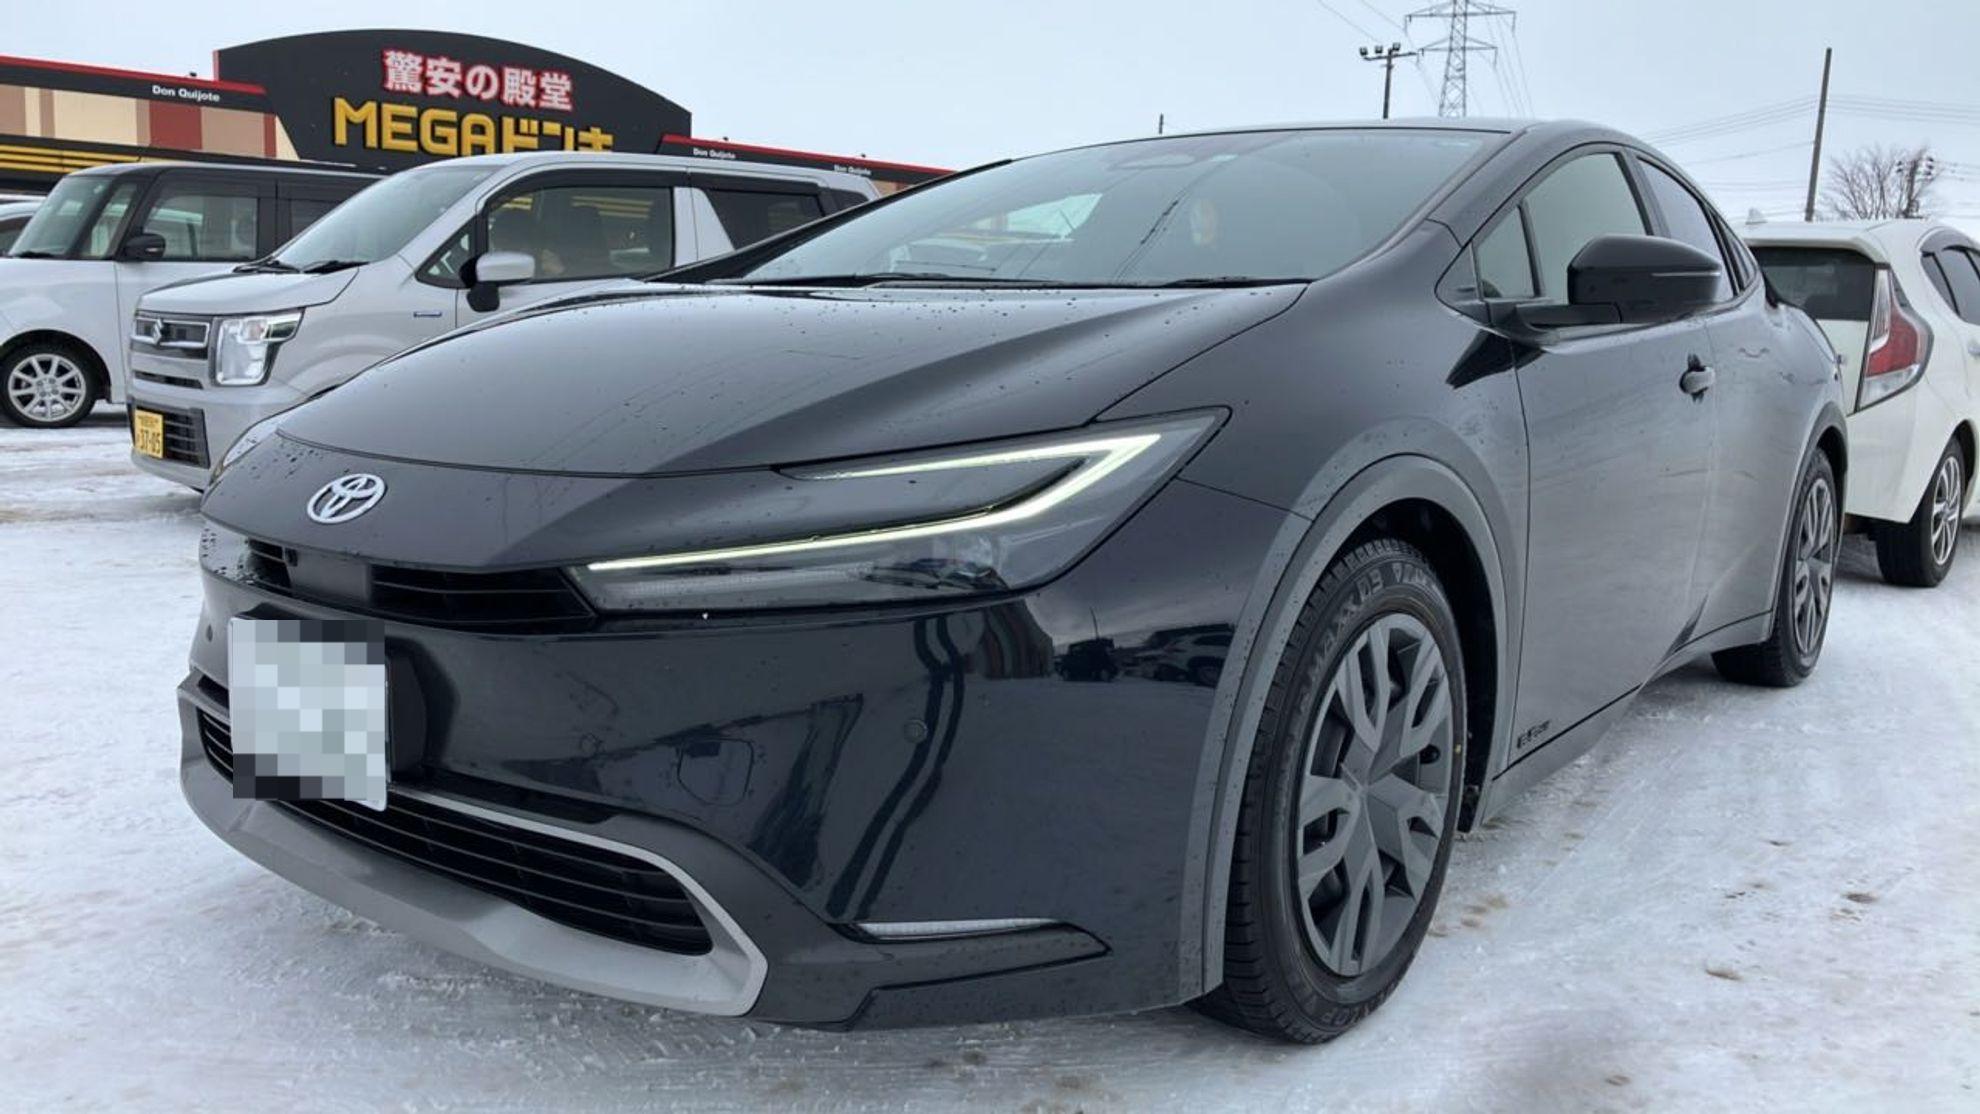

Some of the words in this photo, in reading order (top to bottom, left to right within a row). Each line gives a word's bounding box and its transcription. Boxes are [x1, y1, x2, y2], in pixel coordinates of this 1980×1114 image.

[152, 85, 175, 96] Don
[178, 88, 220, 102] Quijote
[383, 50, 573, 111] 驚安の殿堂
